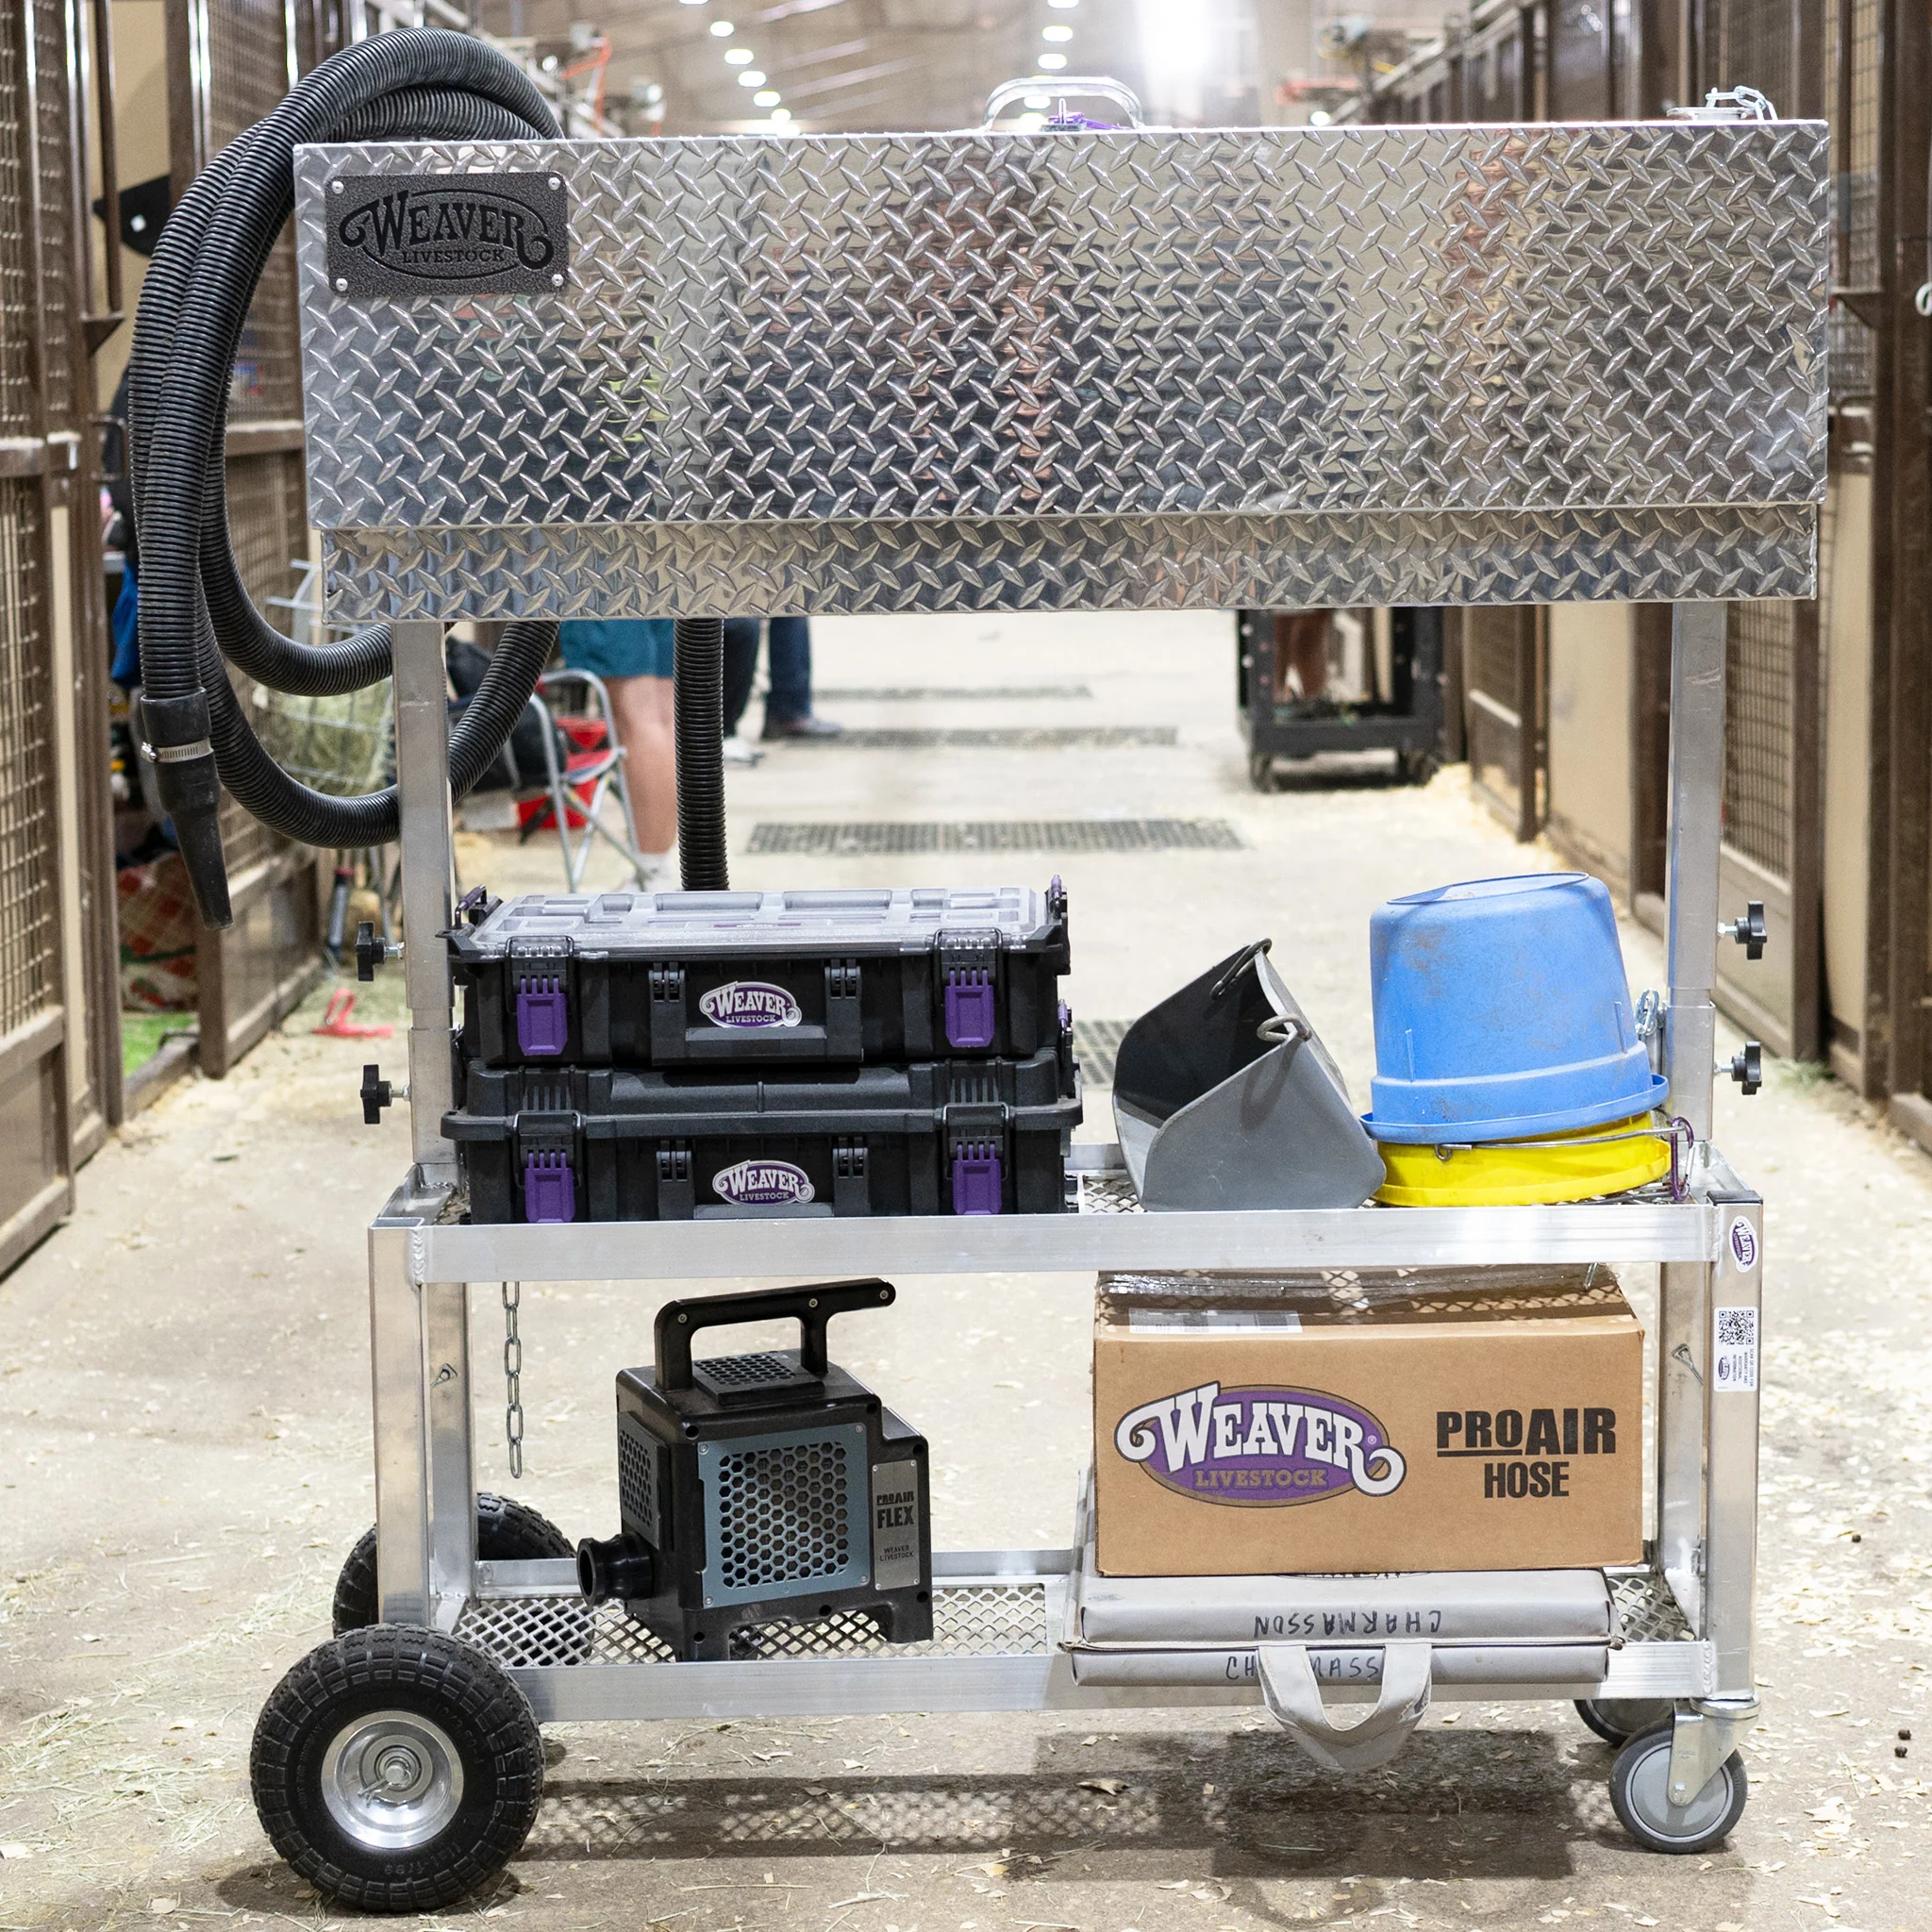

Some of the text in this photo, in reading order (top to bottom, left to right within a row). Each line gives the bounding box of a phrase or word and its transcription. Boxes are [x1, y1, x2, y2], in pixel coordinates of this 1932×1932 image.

[339, 191, 555, 270] WEAVER
[403, 249, 506, 263] LIVESTOCK
[700, 986, 801, 1025] WEAVER
[725, 1015, 776, 1024] LIVESTOCK
[713, 1163, 814, 1203] WEAVER
[739, 1191, 790, 1201] LIVESTOCK
[1736, 1220, 1754, 1270] WEAVER
[1114, 1380, 1407, 1497] WEAVER
[1437, 1407, 1616, 1457] PROAIR
[1195, 1469, 1327, 1488] LIVESTOCK
[1485, 1461, 1570, 1498] HOSE
[877, 1506, 914, 1529] FLEX
[880, 1552, 914, 1562] LIVESTOCK
[884, 1545, 909, 1554] WEAVER
[1254, 1610, 1441, 1639] CHARMASSON
[1225, 1656, 1380, 1681] CHMASS
